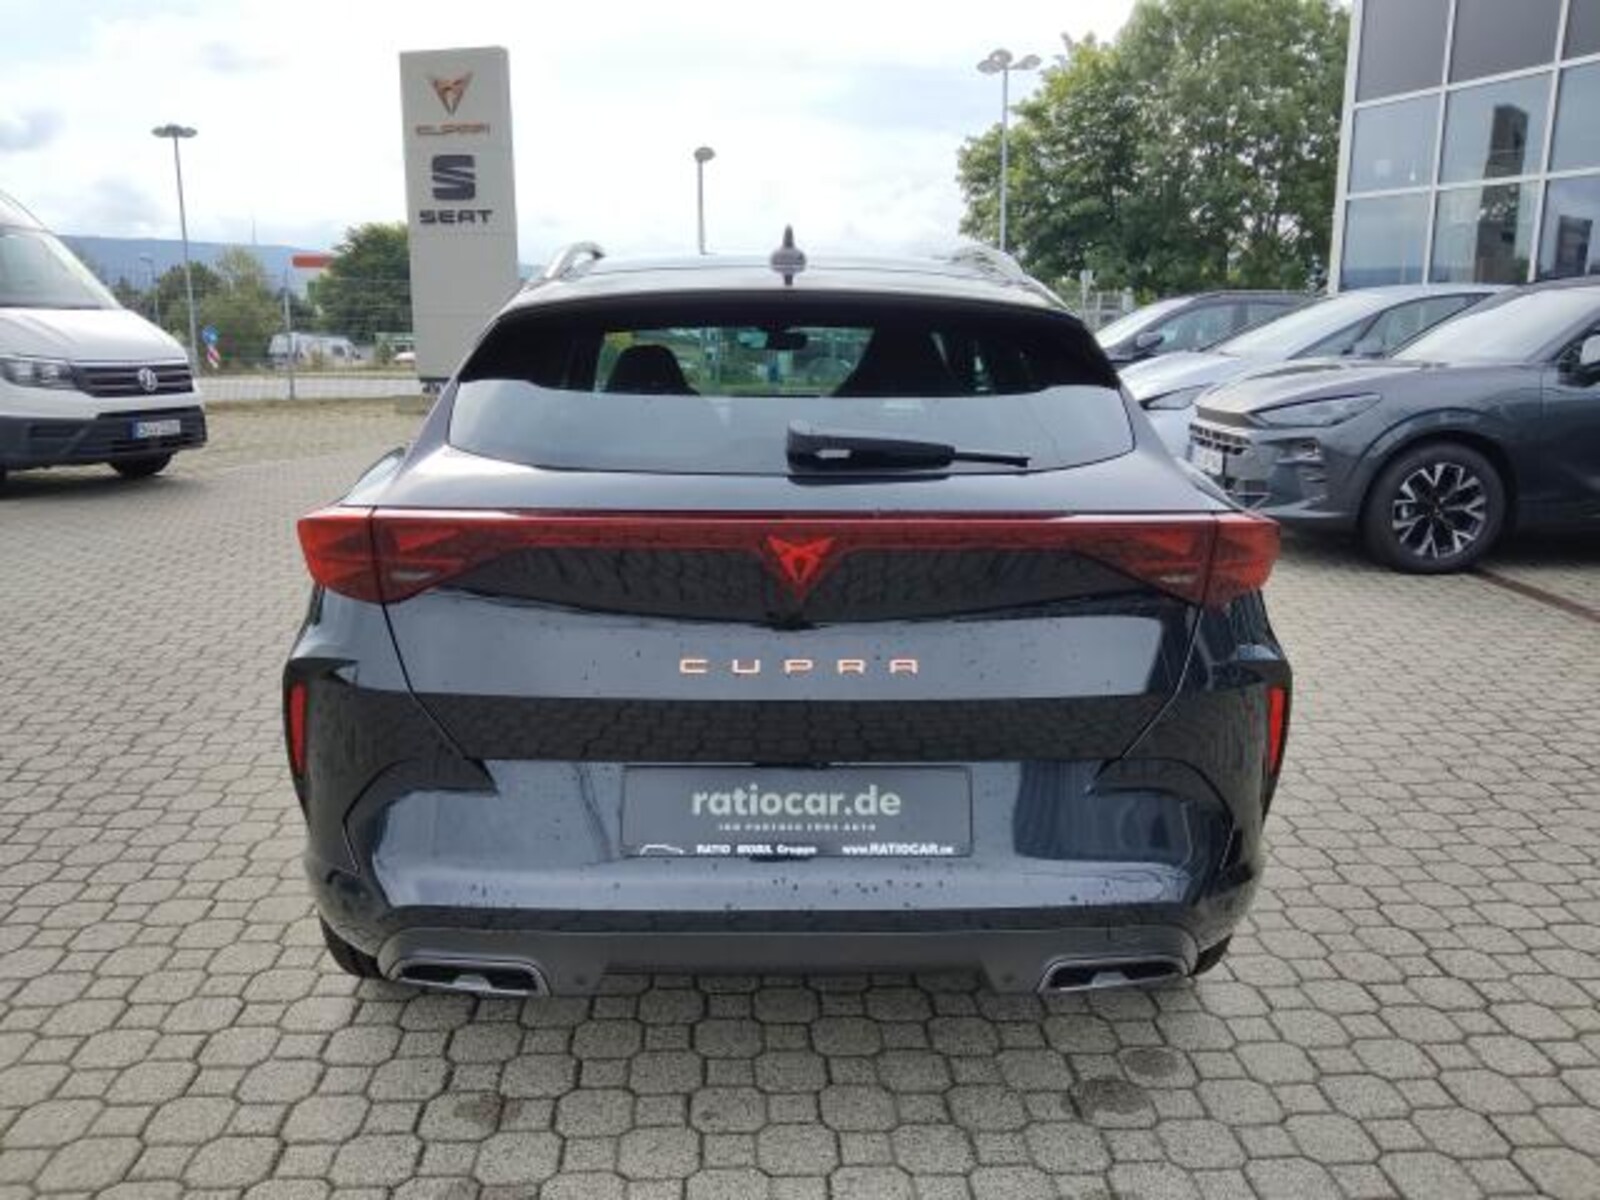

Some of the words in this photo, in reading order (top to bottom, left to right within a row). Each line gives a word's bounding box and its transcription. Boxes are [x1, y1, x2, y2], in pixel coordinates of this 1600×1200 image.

[420, 209, 493, 223] SEAT
[680, 658, 918, 675] CUPRA
[691, 784, 901, 816] ratiocar.de
